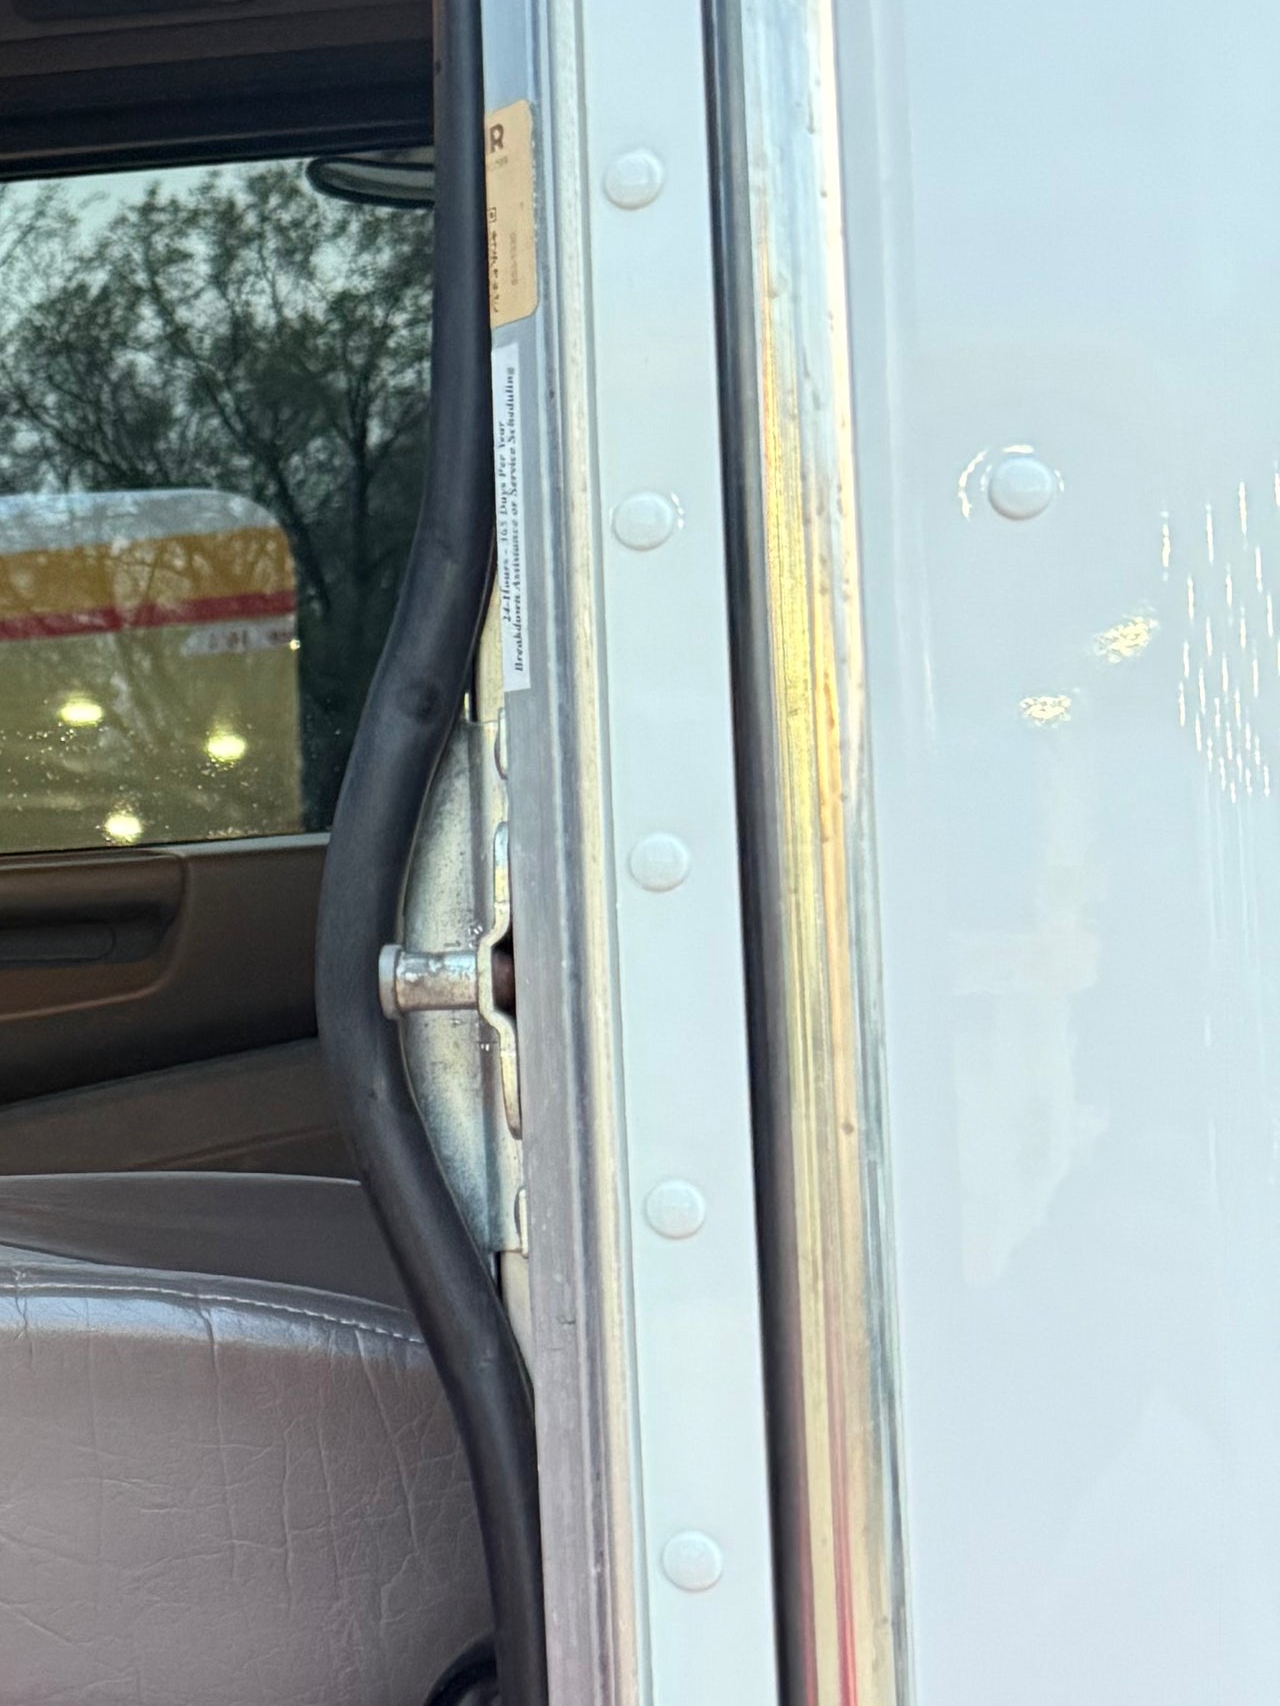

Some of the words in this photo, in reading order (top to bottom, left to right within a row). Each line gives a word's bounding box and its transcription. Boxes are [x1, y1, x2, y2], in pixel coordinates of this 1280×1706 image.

[502, 367, 518, 444] Scheduling
[497, 454, 506, 476] Per
[507, 446, 518, 496] Service
[510, 594, 525, 671] Breakdown
